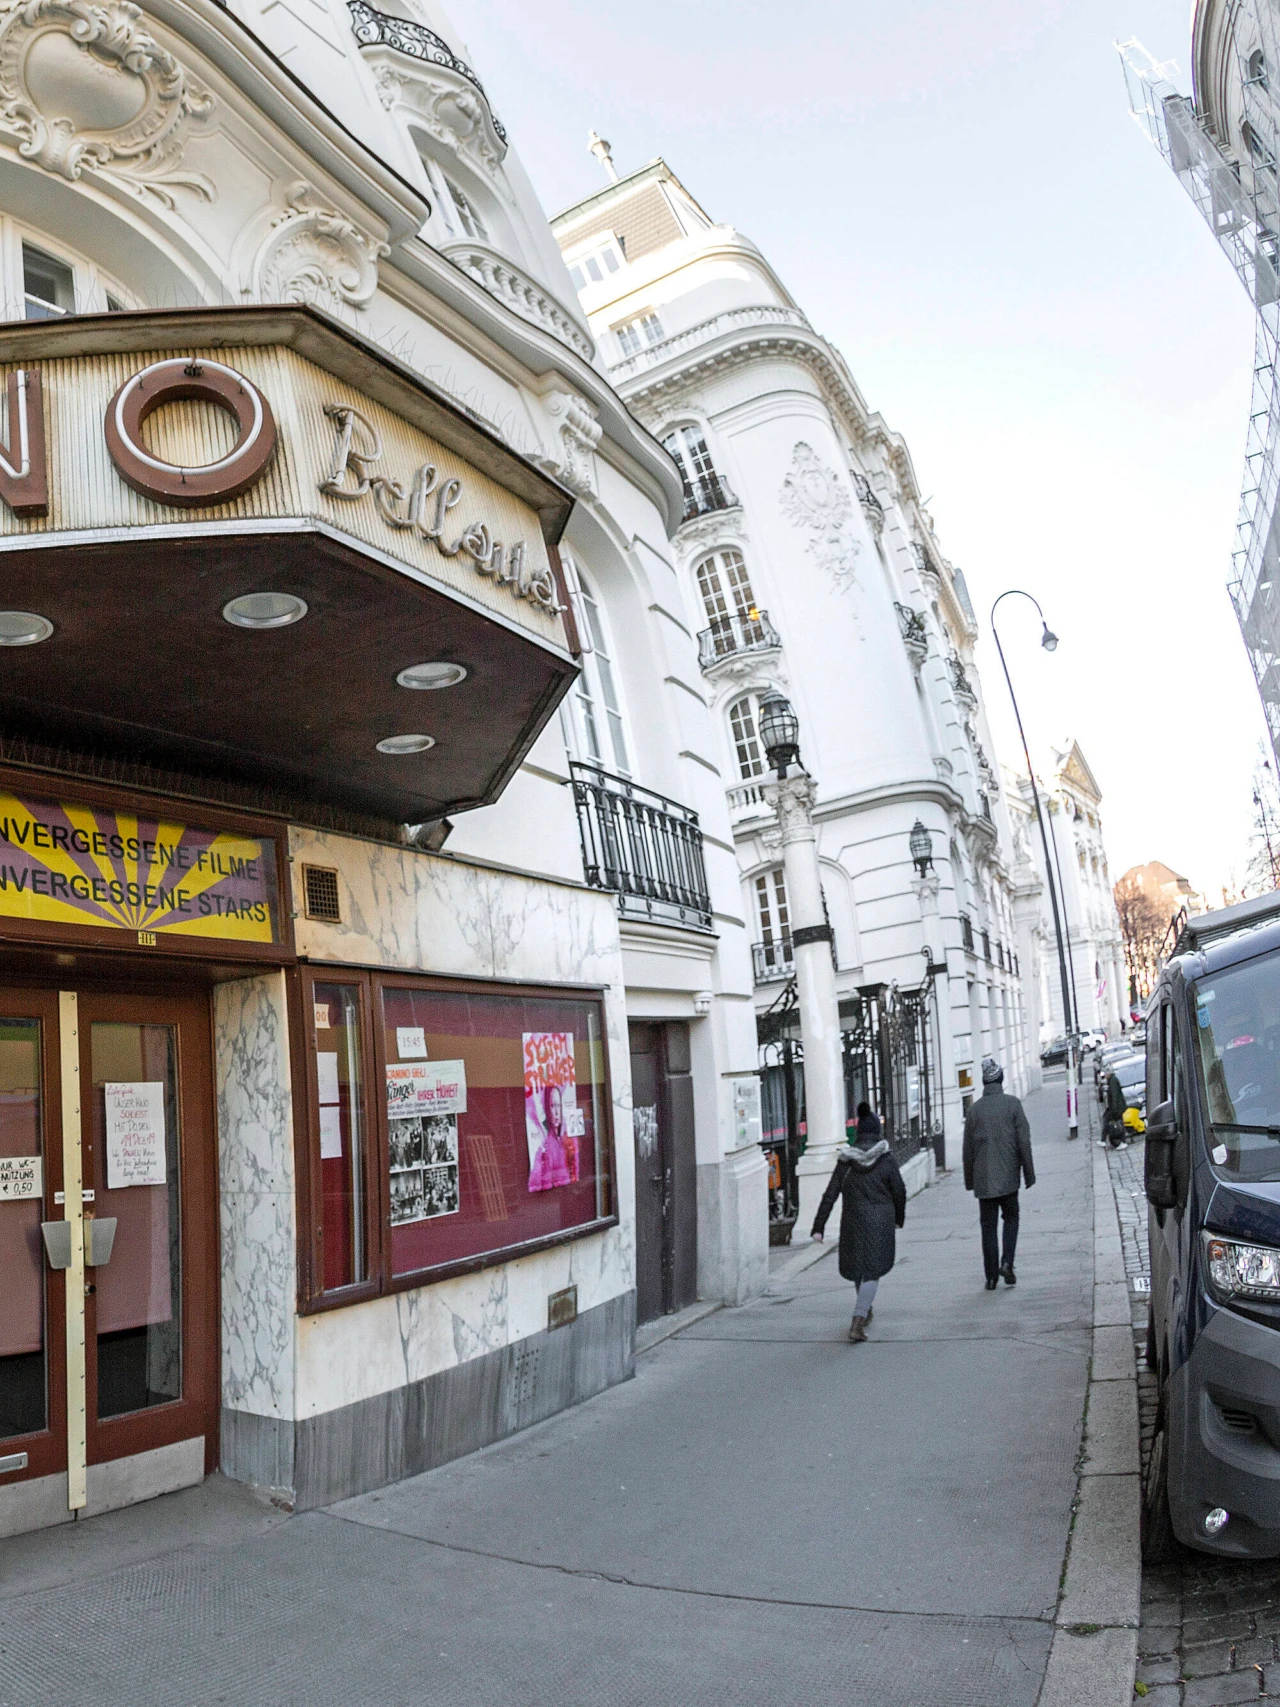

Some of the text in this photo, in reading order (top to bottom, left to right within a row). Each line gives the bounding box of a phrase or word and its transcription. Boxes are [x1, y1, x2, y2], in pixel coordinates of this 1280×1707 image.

[317, 402, 568, 616] Bellaria
[197, 849, 259, 881] FILME
[198, 892, 267, 923] STARS
[13, 1182, 33, 1195] 0,50
